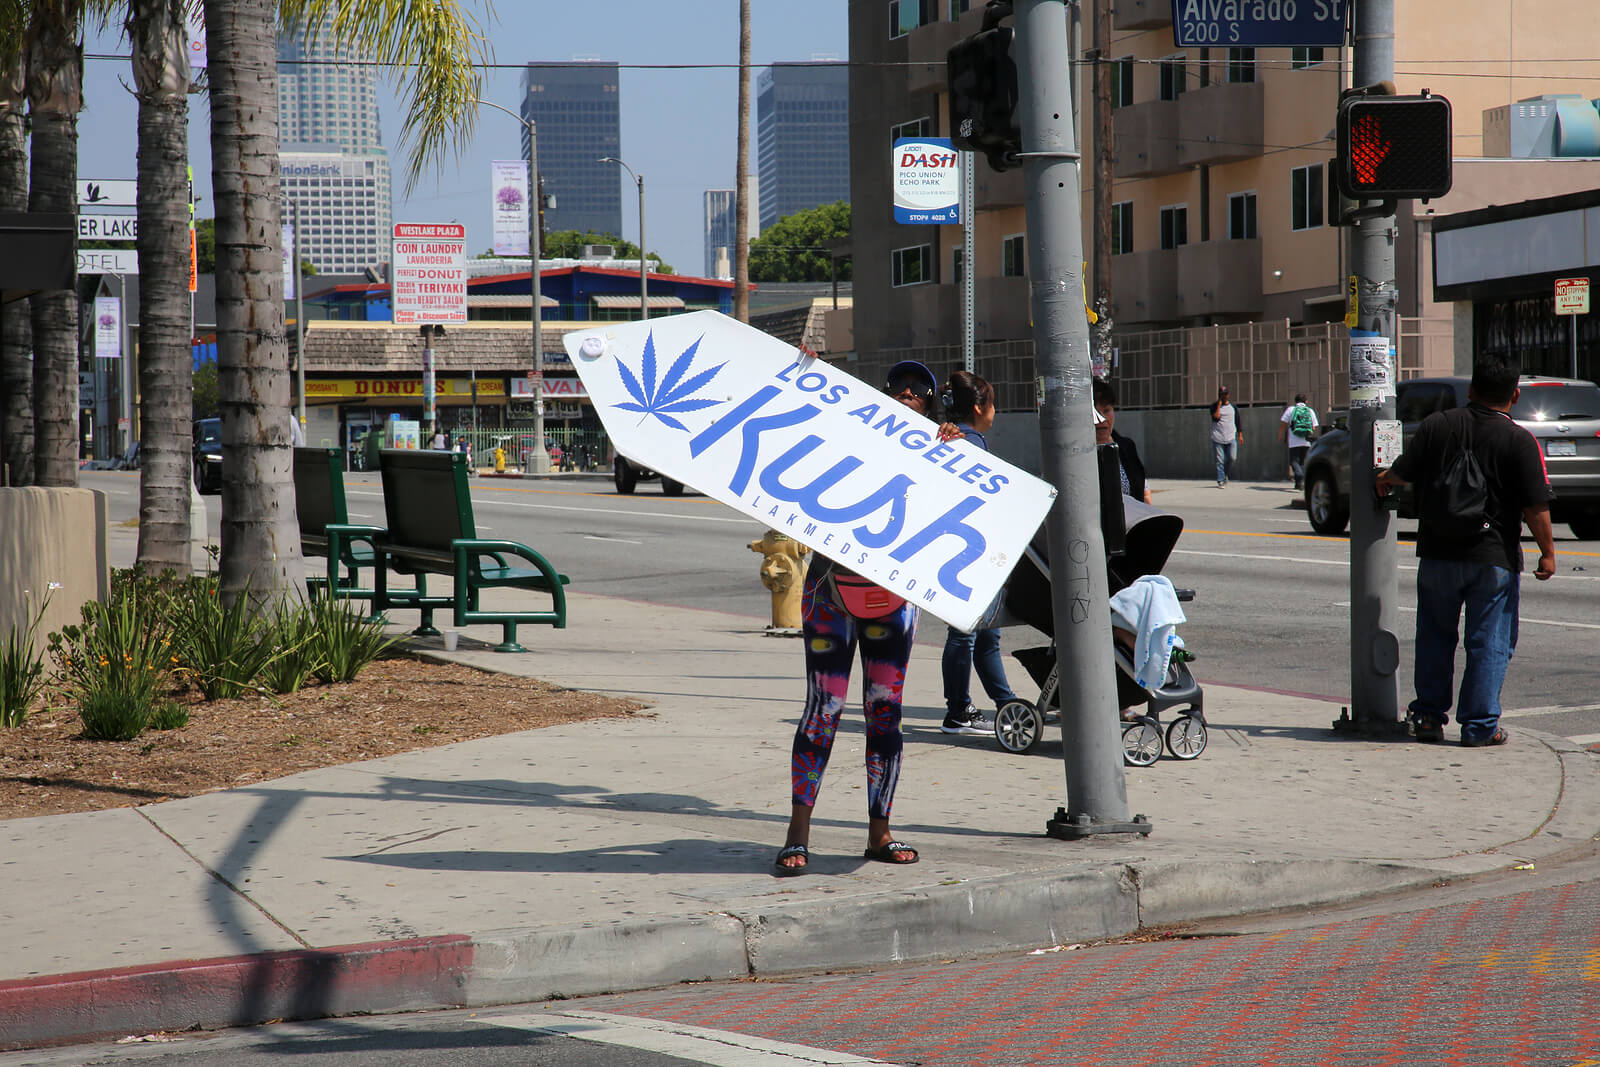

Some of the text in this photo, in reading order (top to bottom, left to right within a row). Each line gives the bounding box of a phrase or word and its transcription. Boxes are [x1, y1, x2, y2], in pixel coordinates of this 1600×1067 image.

[1183, 0, 1341, 21] Alvarado St
[1183, 22, 1240, 42] 200 S
[901, 153, 957, 168] DASH
[279, 164, 341, 176] nionBank
[400, 226, 460, 236] WESTLAKE PLAZA
[396, 243, 463, 254] COIN LAUNDRY
[406, 255, 453, 265] LAVANDERIA
[418, 269, 463, 279] DONUT
[418, 283, 464, 294] TERIYAKI
[1556, 286, 1568, 296] NO
[417, 295, 442, 305] BEAUTY
[443, 295, 464, 305] SALON
[1571, 295, 1584, 303] TIME
[481, 382, 503, 392] CREAM
[774, 361, 1010, 495] LOS ANGELES
[689, 385, 987, 602] Kush
[752, 495, 937, 602] LAKMEDS.COM
